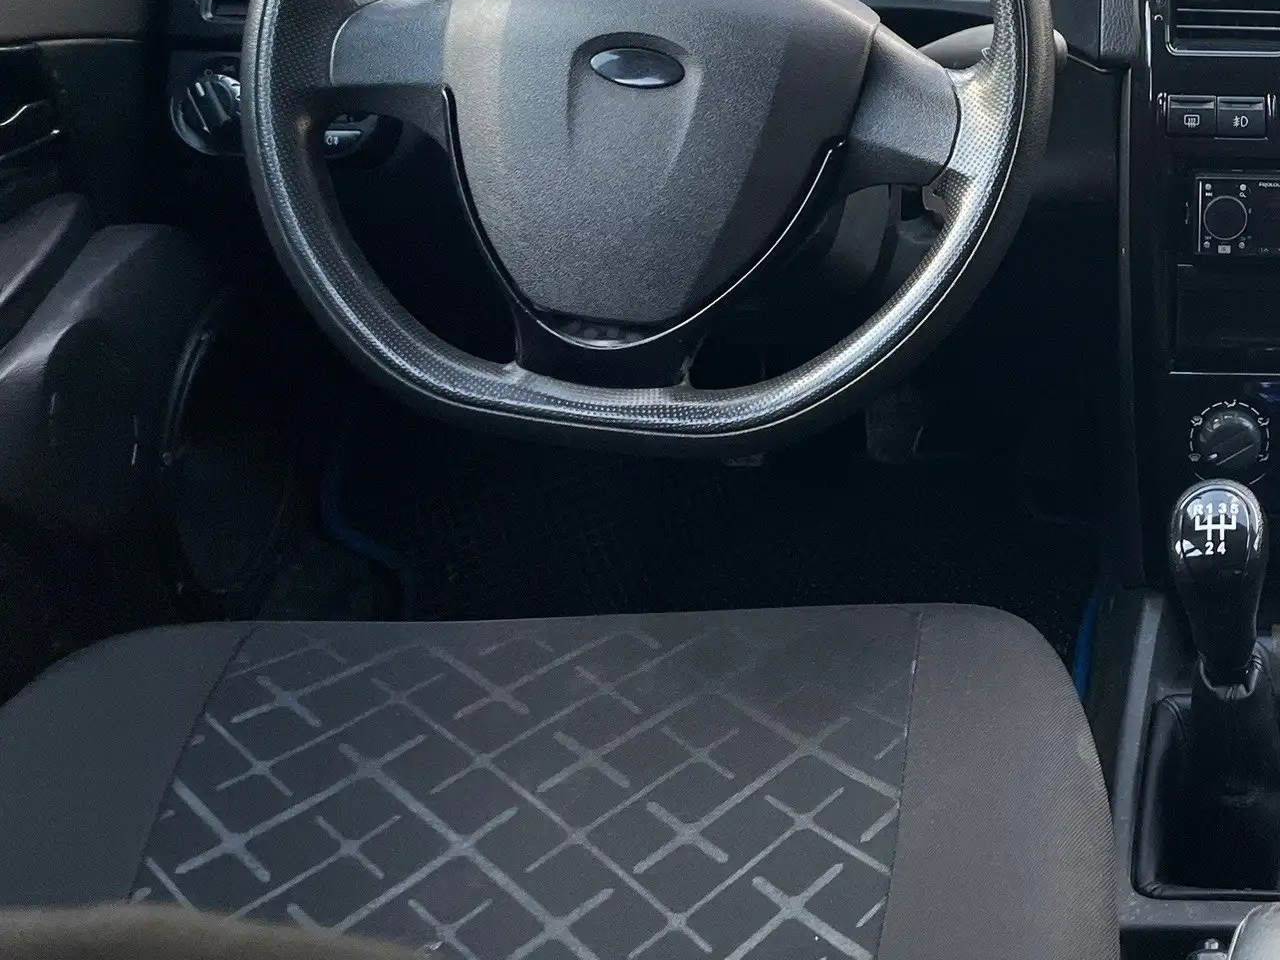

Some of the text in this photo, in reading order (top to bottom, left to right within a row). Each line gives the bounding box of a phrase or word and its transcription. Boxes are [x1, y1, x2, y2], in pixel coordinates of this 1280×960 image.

[1193, 503, 1239, 516] R 1 3 5
[1205, 541, 1226, 555] 2 4
